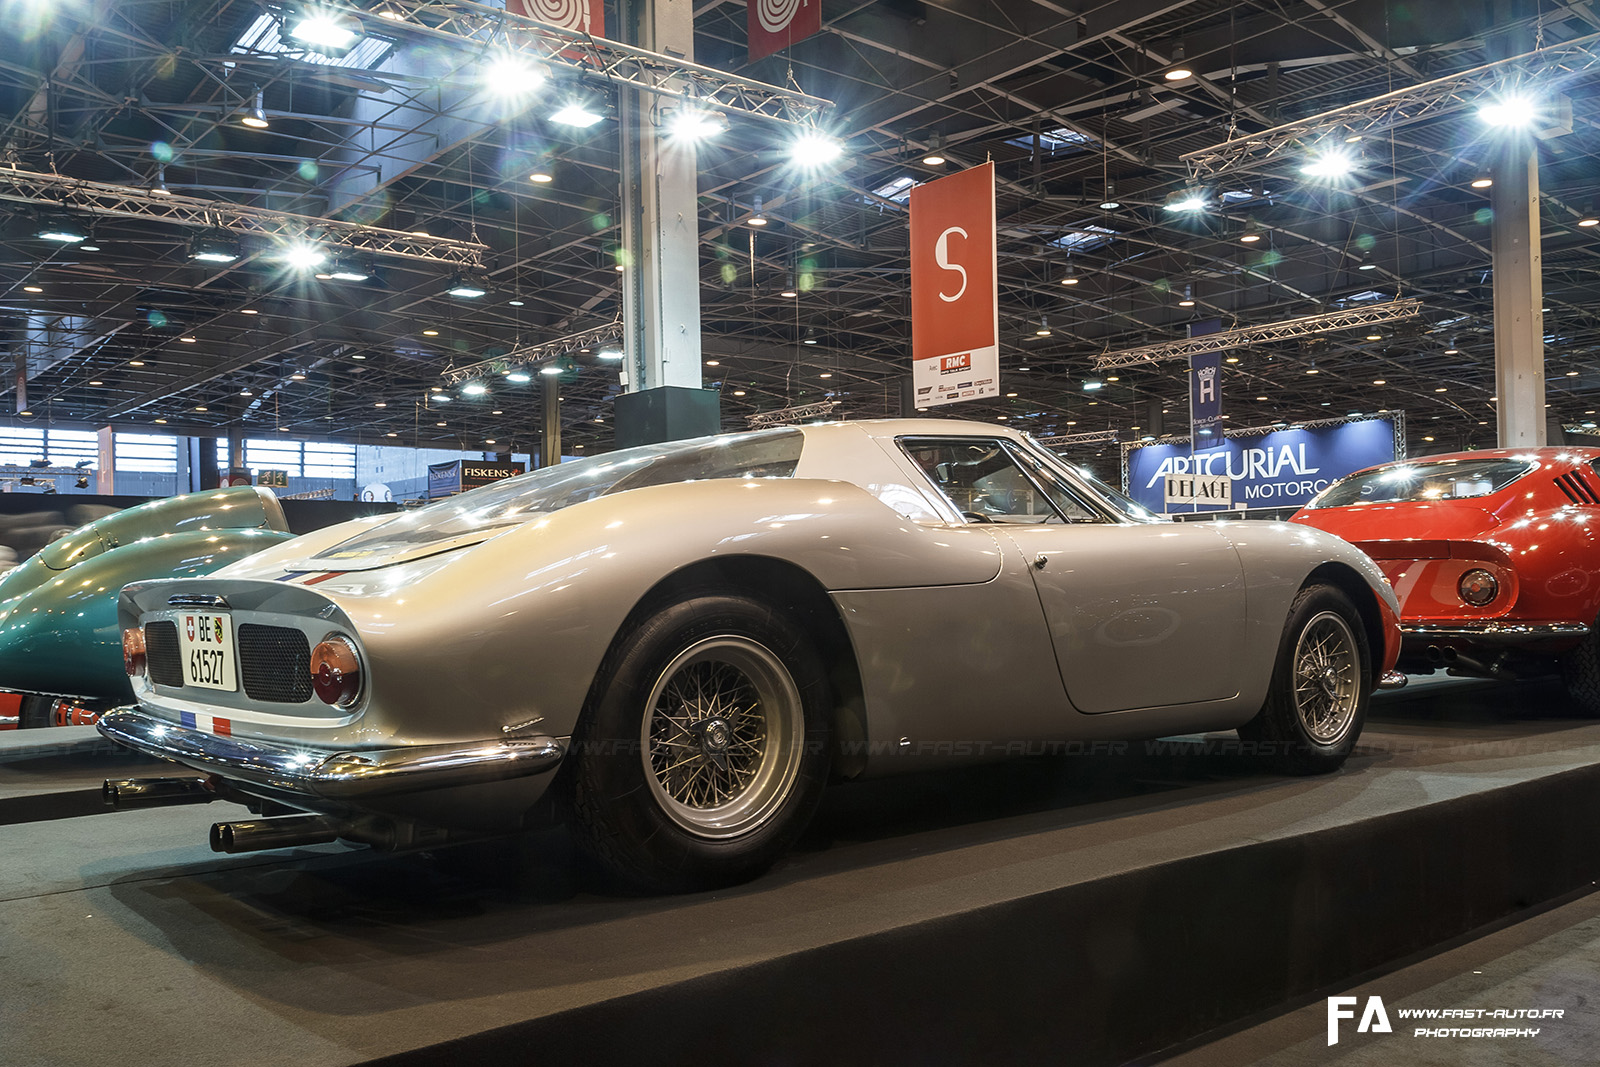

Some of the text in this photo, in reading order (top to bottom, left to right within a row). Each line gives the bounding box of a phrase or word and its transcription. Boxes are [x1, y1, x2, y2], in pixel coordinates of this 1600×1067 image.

[935, 226, 969, 303] S
[946, 355, 966, 369] RMC
[464, 468, 509, 478] FISKENS
[1168, 479, 1230, 499] DELAGE
[199, 616, 211, 642] BE
[191, 649, 224, 685] 61527
